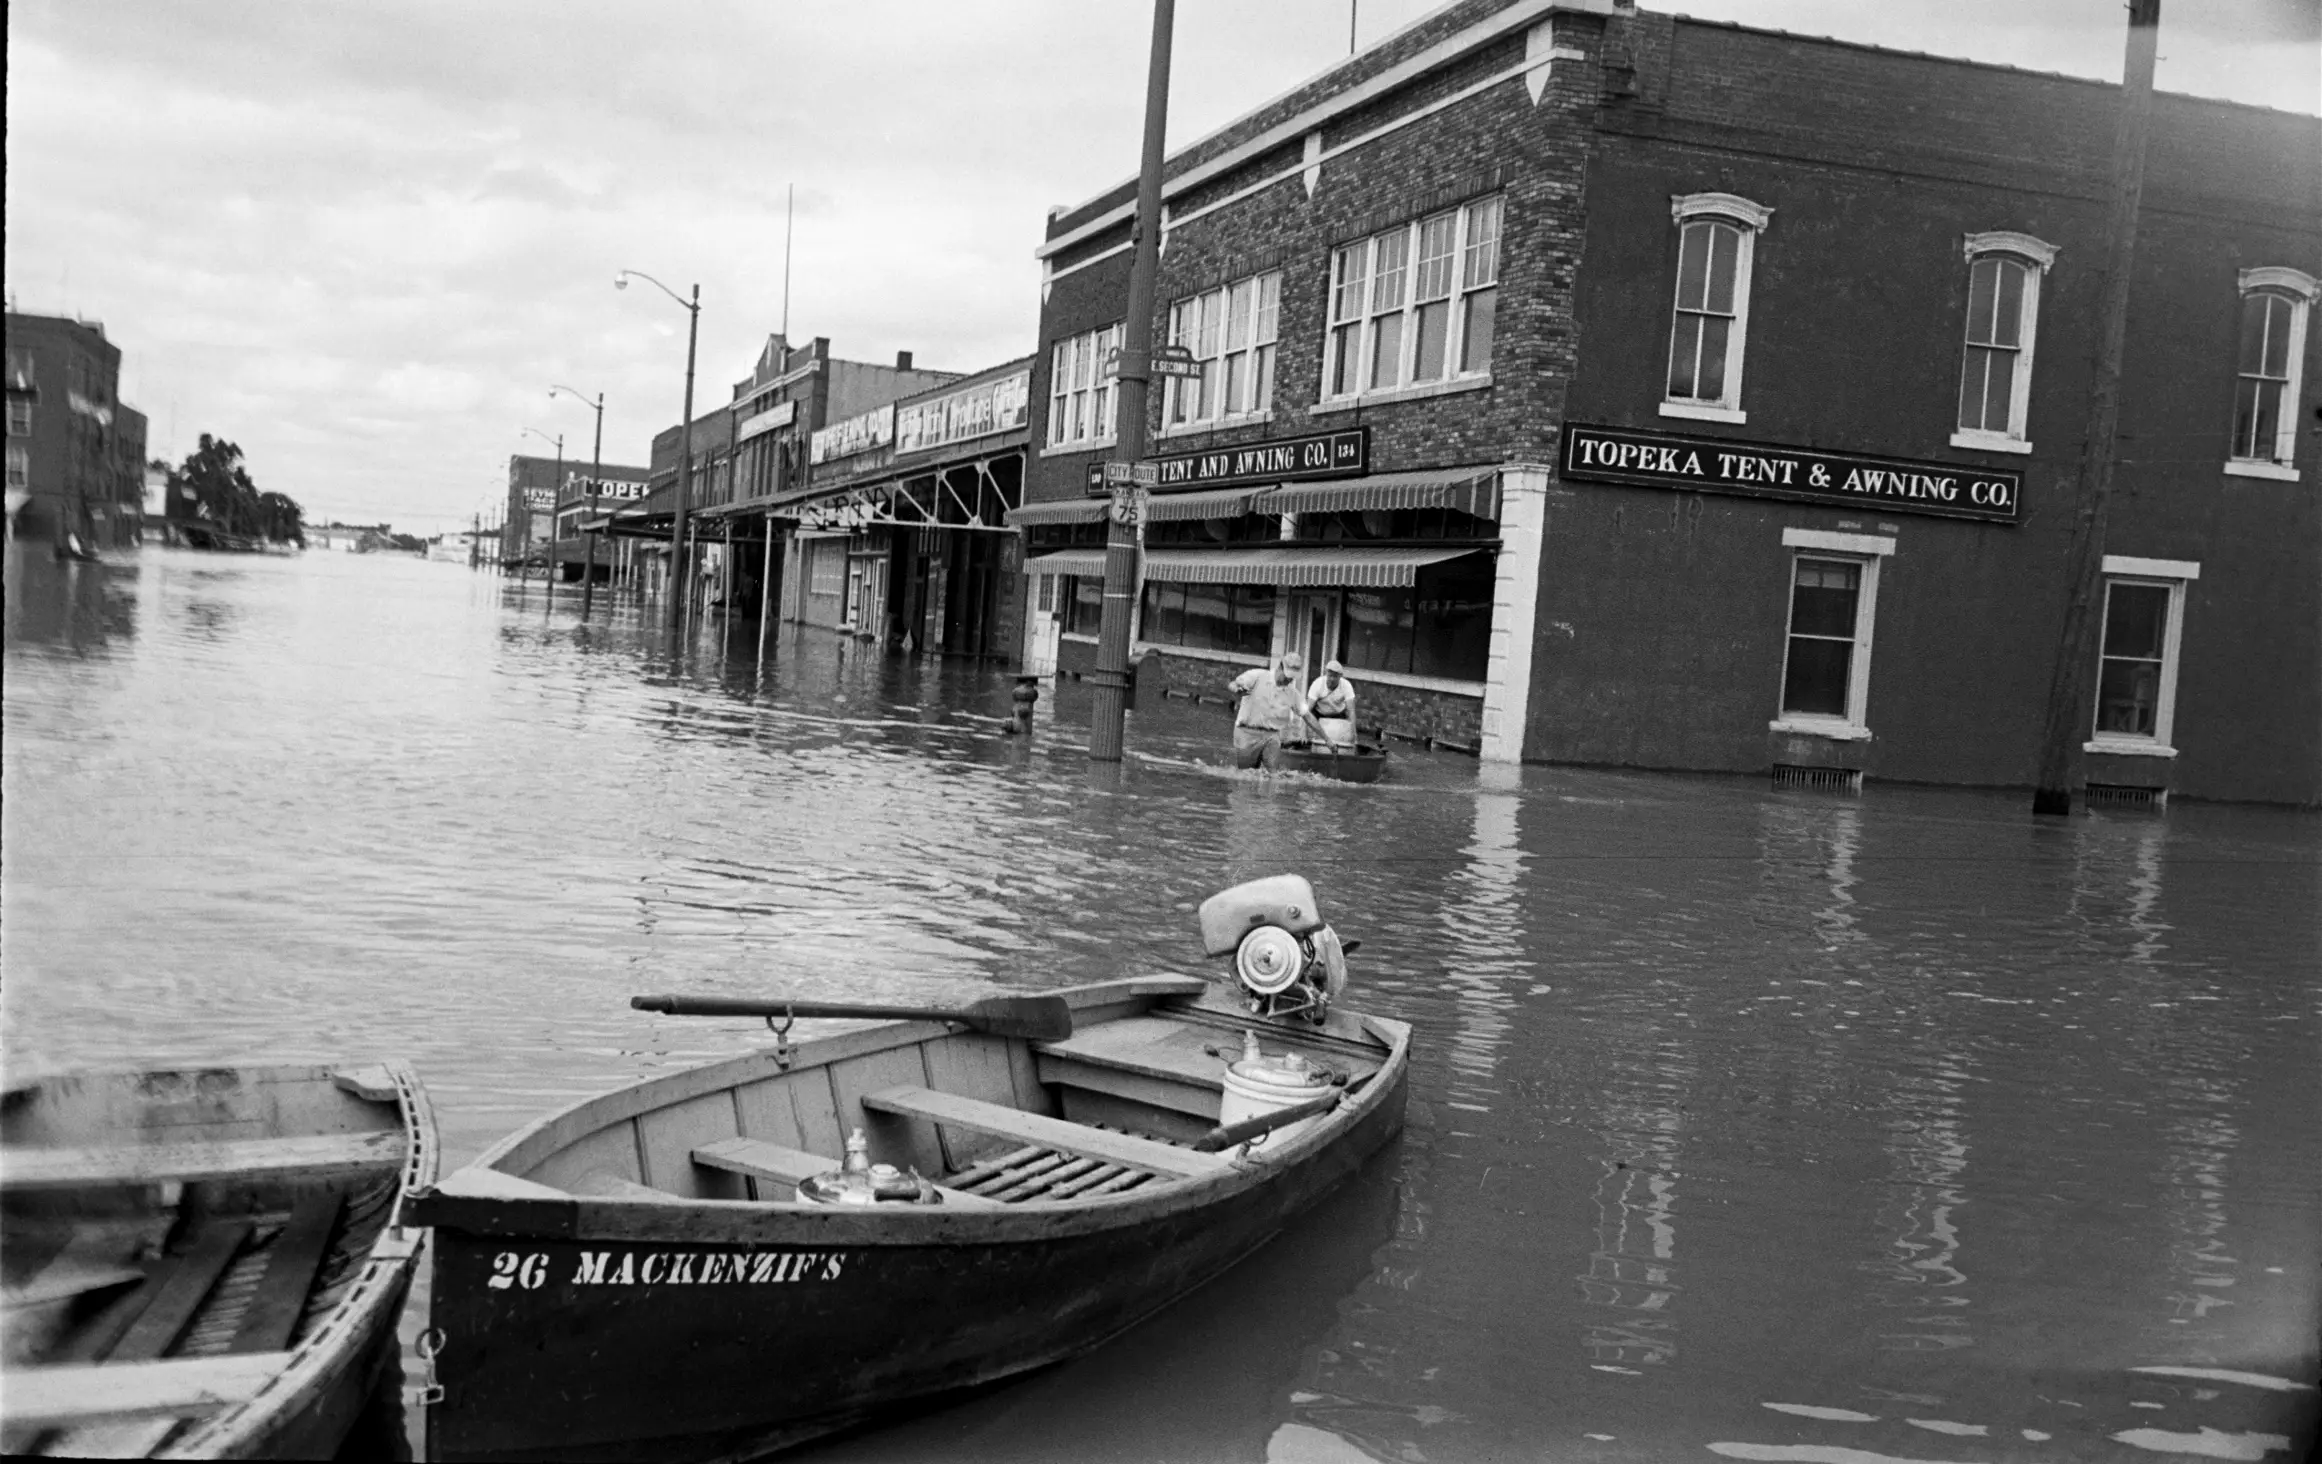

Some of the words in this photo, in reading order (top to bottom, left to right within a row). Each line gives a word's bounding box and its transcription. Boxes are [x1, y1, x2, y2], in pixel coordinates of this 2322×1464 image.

[1160, 361, 1188, 374] SECOND
[1109, 466, 1128, 478] CITY
[1161, 458, 1195, 482] TENT
[1199, 453, 1229, 477] AND
[1235, 446, 1295, 476] AWNING
[1304, 442, 1328, 466] CO.
[1578, 438, 1705, 476] TOPEKA
[1717, 452, 1799, 485] TENT
[1808, 463, 1831, 488] &
[1841, 467, 1959, 502] AWNING
[1969, 481, 2014, 507] CO.
[1119, 505, 1138, 520] 75
[487, 1252, 550, 1290] 26
